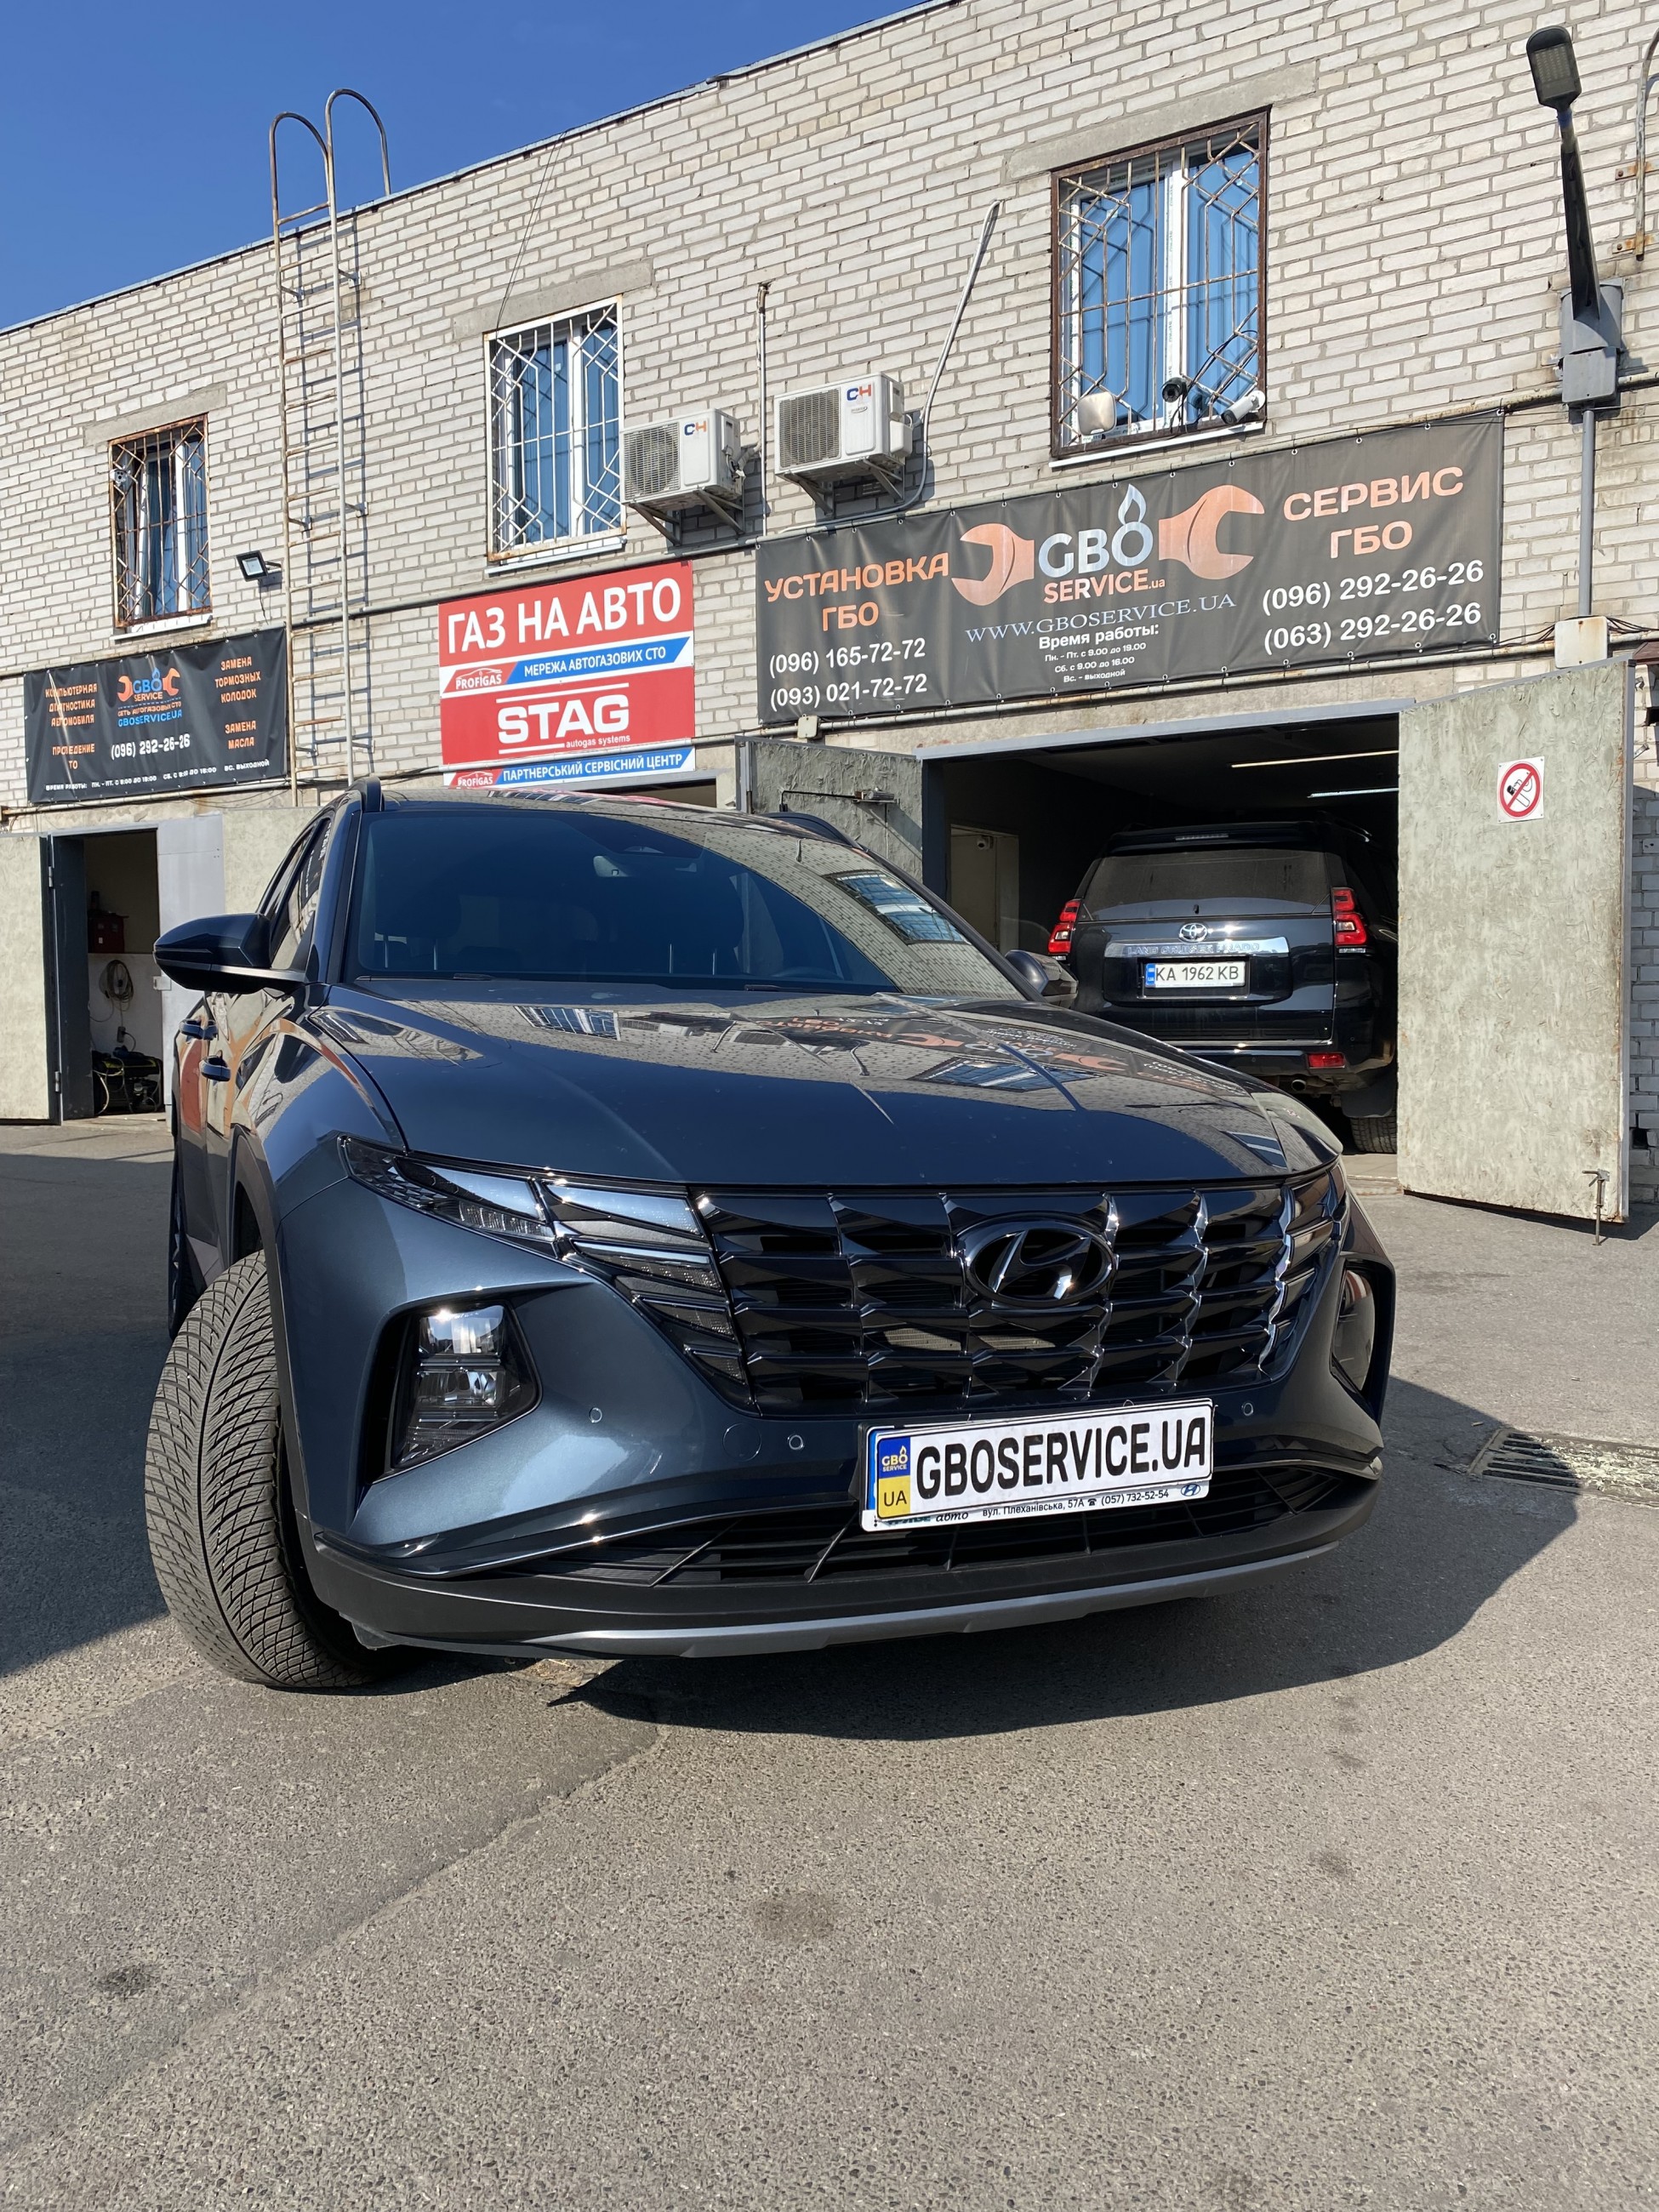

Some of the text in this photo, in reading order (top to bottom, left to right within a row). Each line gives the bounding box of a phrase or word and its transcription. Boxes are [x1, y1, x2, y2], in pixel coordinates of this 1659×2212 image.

[847, 384, 873, 402] CH
[1283, 466, 1464, 522] СЕРВИС
[1039, 521, 1154, 579] GBO
[1330, 521, 1413, 559] ГБО
[764, 551, 950, 603] УСТАНОВКА
[1263, 559, 1484, 616] (096) 292-26-26
[448, 578, 681, 653] ГАЗ НА АВТО
[822, 601, 880, 632] ГБО
[1039, 624, 1160, 651] Время работы:
[1264, 601, 1482, 656] (063) 292-26-26
[769, 637, 926, 678] (096) 165-72-72
[1088, 647, 1108, 656] 9.00
[1123, 642, 1147, 652] 19.00
[220, 656, 253, 671] ЗАМЕНА
[524, 647, 666, 677] МЕРЕЖА АВТОГАЗОВИХ СТО
[1077, 661, 1097, 670] 9.00
[133, 676, 162, 694] GBO
[214, 671, 261, 688] ТОРМОЗНЫХ
[1085, 669, 1126, 681] выходной
[134, 691, 163, 703] SERVICE
[221, 688, 257, 704] КОЛОДОК
[770, 673, 927, 712] (093) 021-72-72
[225, 721, 256, 734] ЗАМЕНА
[498, 694, 630, 744] STAG
[111, 733, 191, 761] (096) 292-26-26
[228, 737, 255, 750] МАСЛА
[566, 734, 630, 749] autogas systems
[68, 760, 78, 770] ТО
[503, 753, 682, 782] ПАРТНЕРСЬКИЙ СЕРВІСНИЙ ЦЕНТР
[1155, 966, 1239, 982] KA 1962 KB
[881, 1453, 909, 1467] GBO
[882, 1463, 908, 1473] SERVICE
[916, 1417, 1206, 1500] GBOSERVICE.UA
[884, 1491, 907, 1507] UA
[983, 1508, 1001, 1518] вул.
[1003, 1501, 1066, 1515] Плеханівська,
[1068, 1498, 1085, 1508] 57А
[1101, 1494, 1124, 1507] (057)
[1126, 1489, 1169, 1502] 732-52-54
